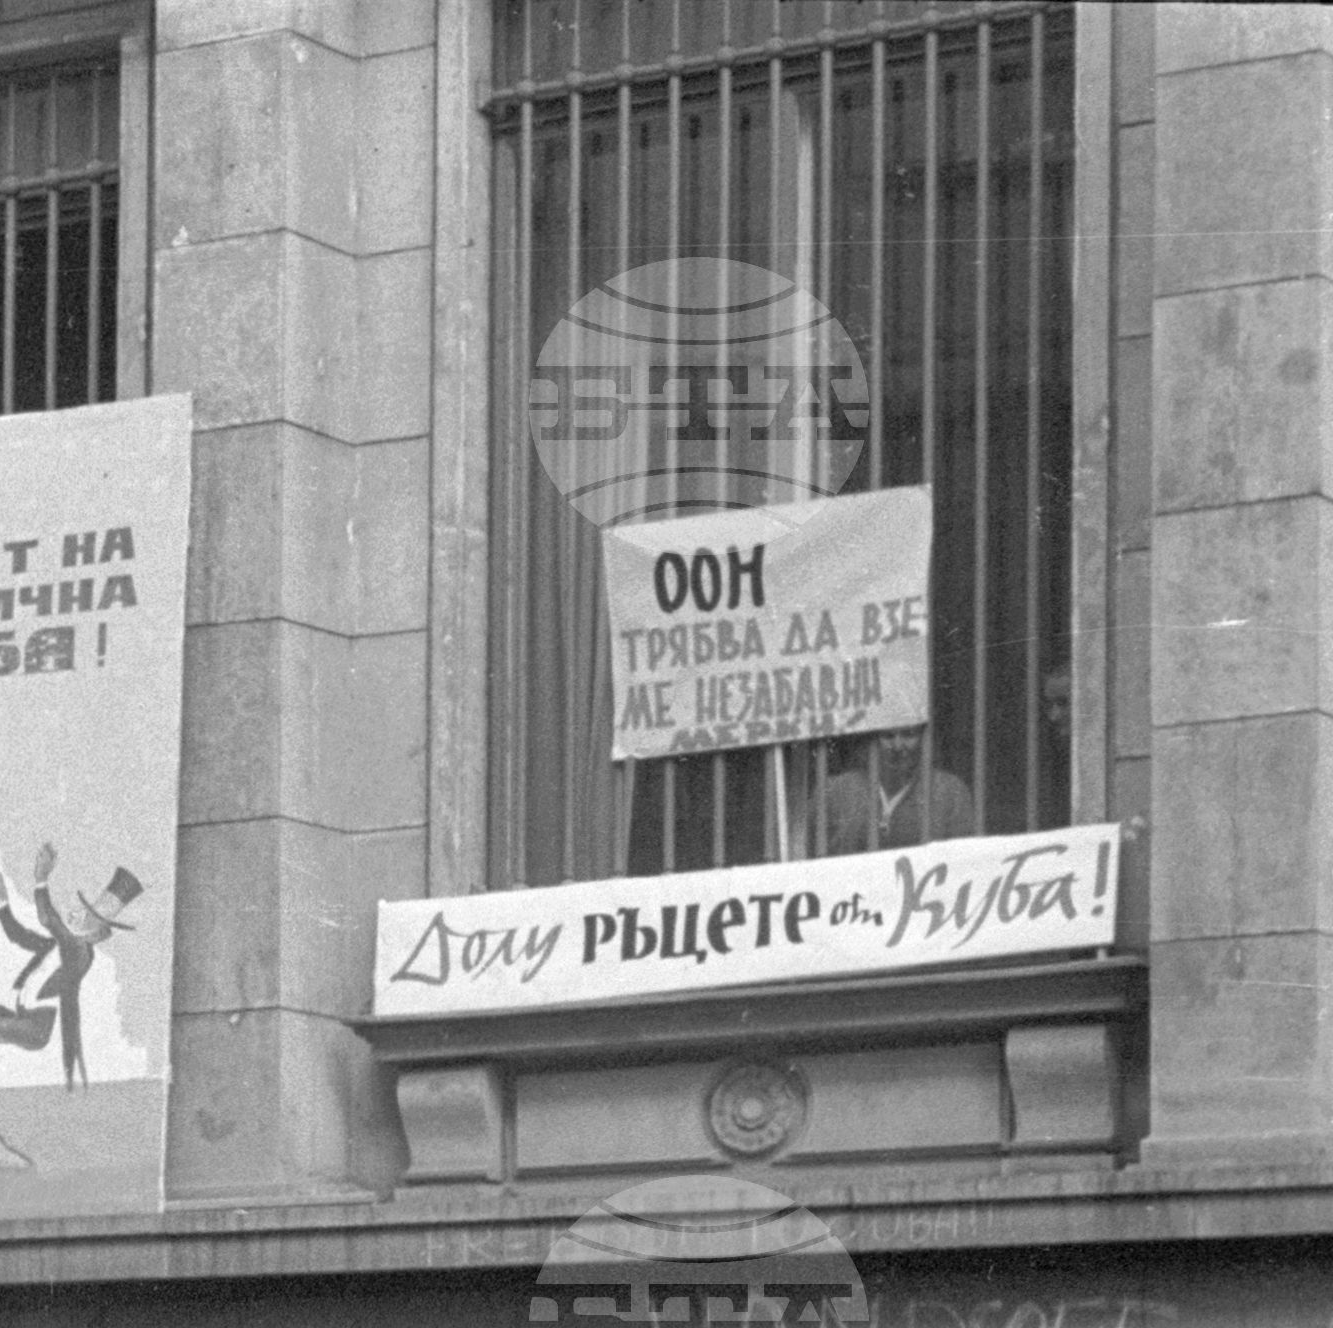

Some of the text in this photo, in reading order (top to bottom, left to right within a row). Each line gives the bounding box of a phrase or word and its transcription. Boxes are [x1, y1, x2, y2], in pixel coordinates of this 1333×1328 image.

[62, 526, 135, 568] НА
[653, 542, 766, 614] ООН
[620, 617, 766, 673] ТРЯБВА
[780, 609, 840, 657] ДА
[620, 657, 884, 732] МЕ НЕЗАБАВНИ
[390, 910, 564, 986] Долу
